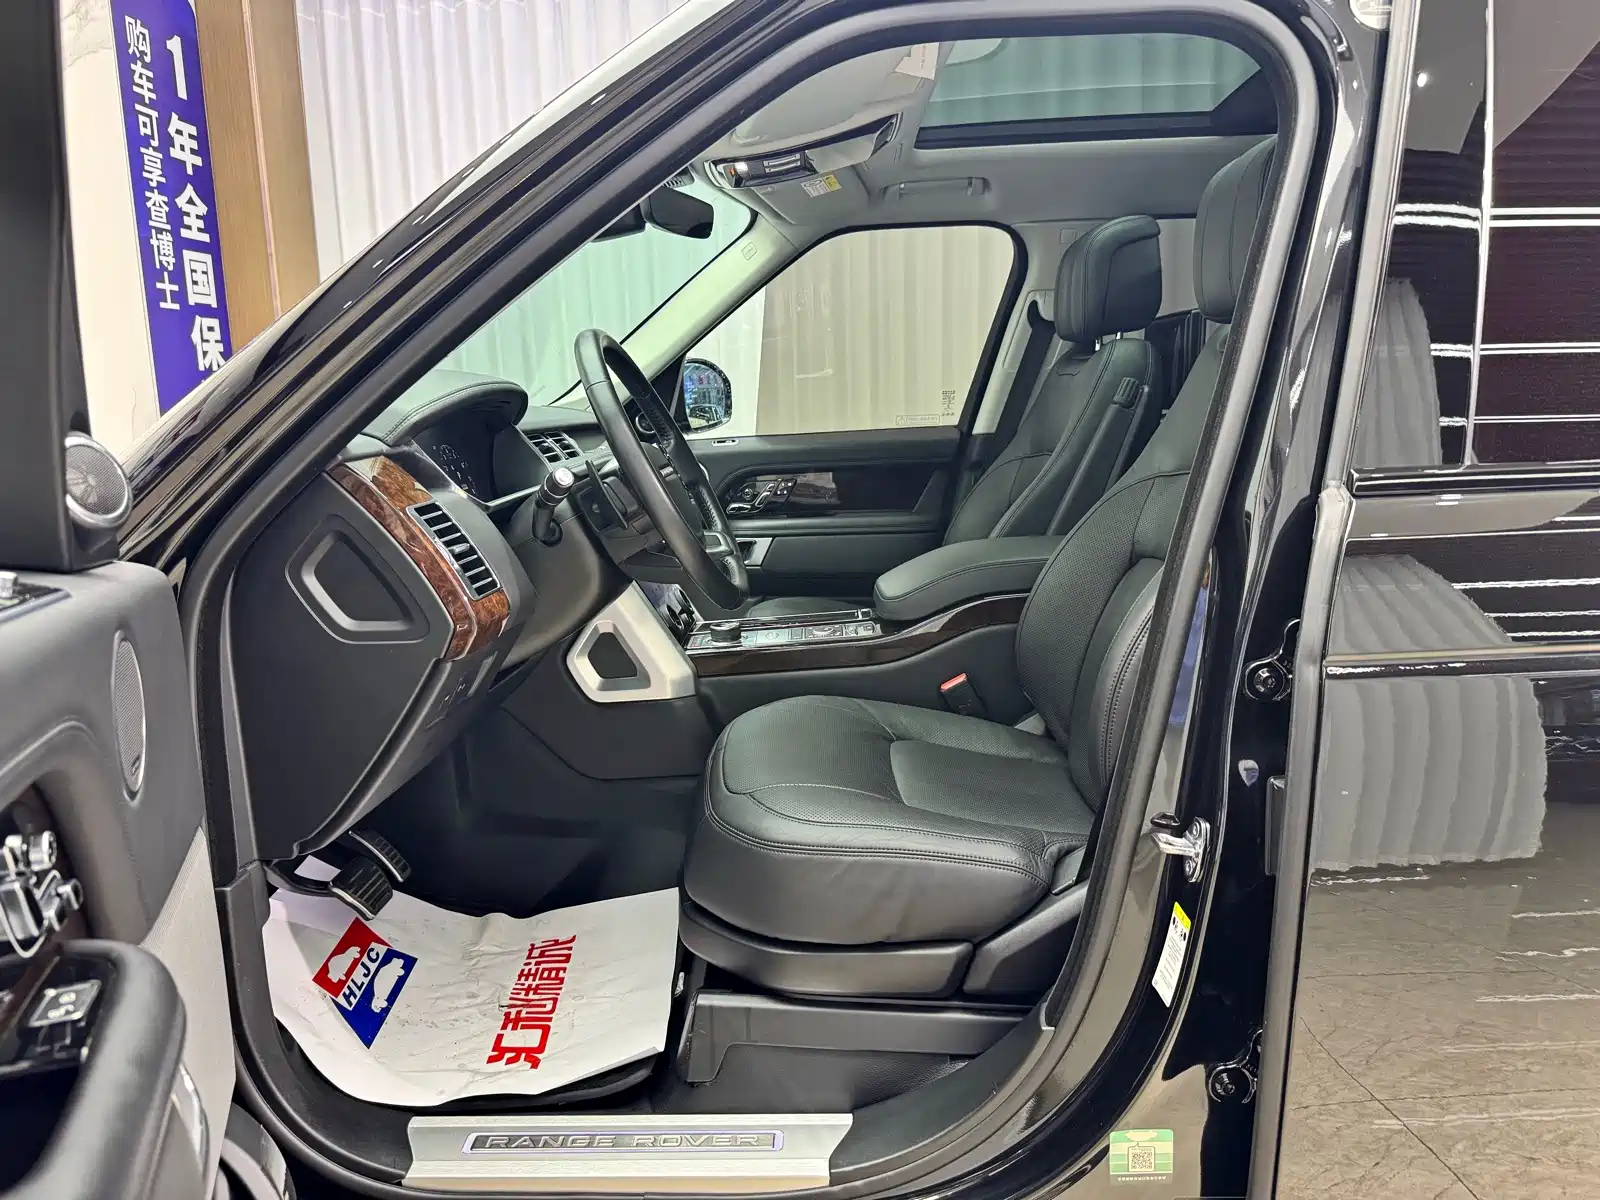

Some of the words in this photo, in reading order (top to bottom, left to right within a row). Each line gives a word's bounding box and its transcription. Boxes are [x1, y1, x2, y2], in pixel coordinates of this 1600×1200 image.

[124, 15, 180, 310] 购车可享查博士
[166, 34, 227, 383] 1年全国保
[343, 946, 379, 1007] HLJC
[486, 934, 576, 1070] 汇利精诚
[485, 1135, 616, 1148] RANGE
[633, 1133, 760, 1147] ROVER
